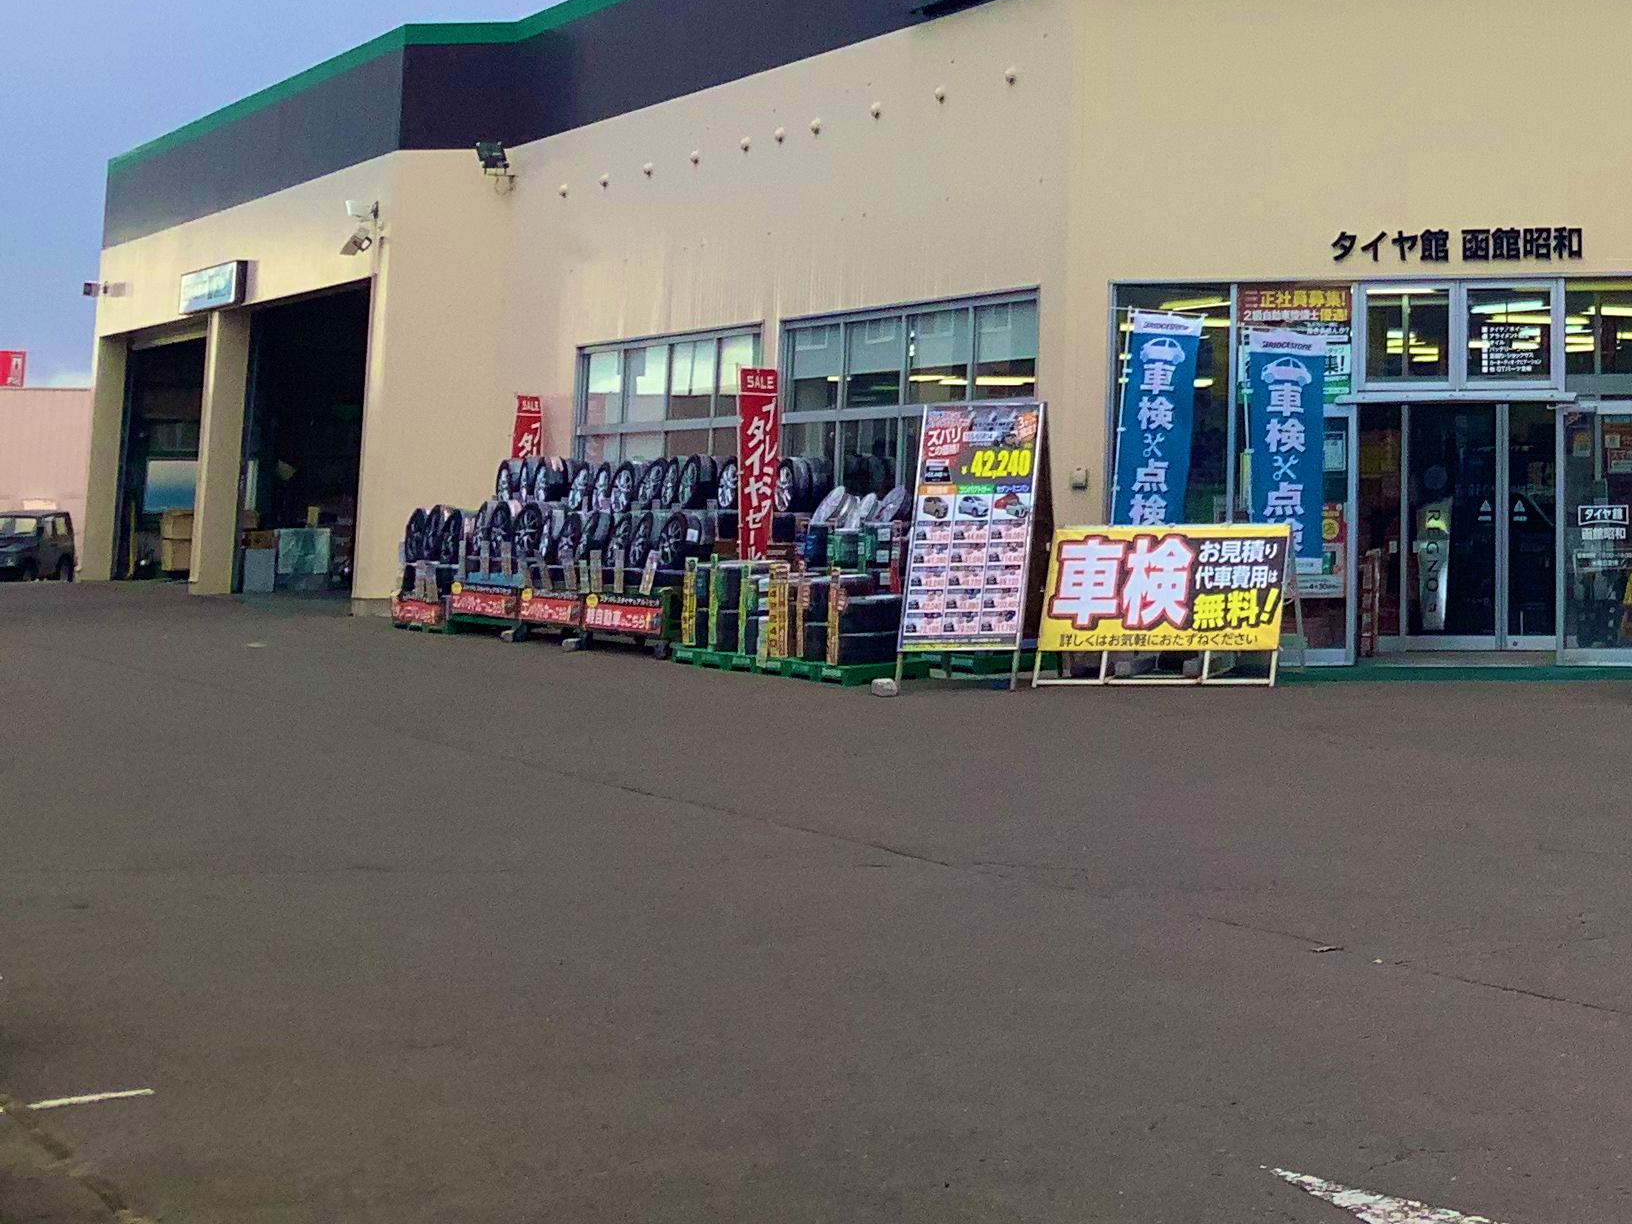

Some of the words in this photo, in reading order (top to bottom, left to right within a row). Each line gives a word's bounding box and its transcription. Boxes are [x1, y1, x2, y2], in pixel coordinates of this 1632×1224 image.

[1331, 229, 1449, 262] タイヤ館
[1461, 227, 1582, 261] 函館昭和
[747, 375, 774, 390] SALE
[927, 426, 961, 447] ズバリ
[1584, 508, 1624, 520] タイヤ館
[1581, 527, 1627, 541] 函館昭和
[1199, 539, 1277, 563] お見積り
[1051, 536, 1193, 628] 車検
[1195, 565, 1278, 590] 代車費用は
[1193, 587, 1280, 628] 無料!
[1059, 633, 1258, 647] 詳しくはお気軽におたずねください
